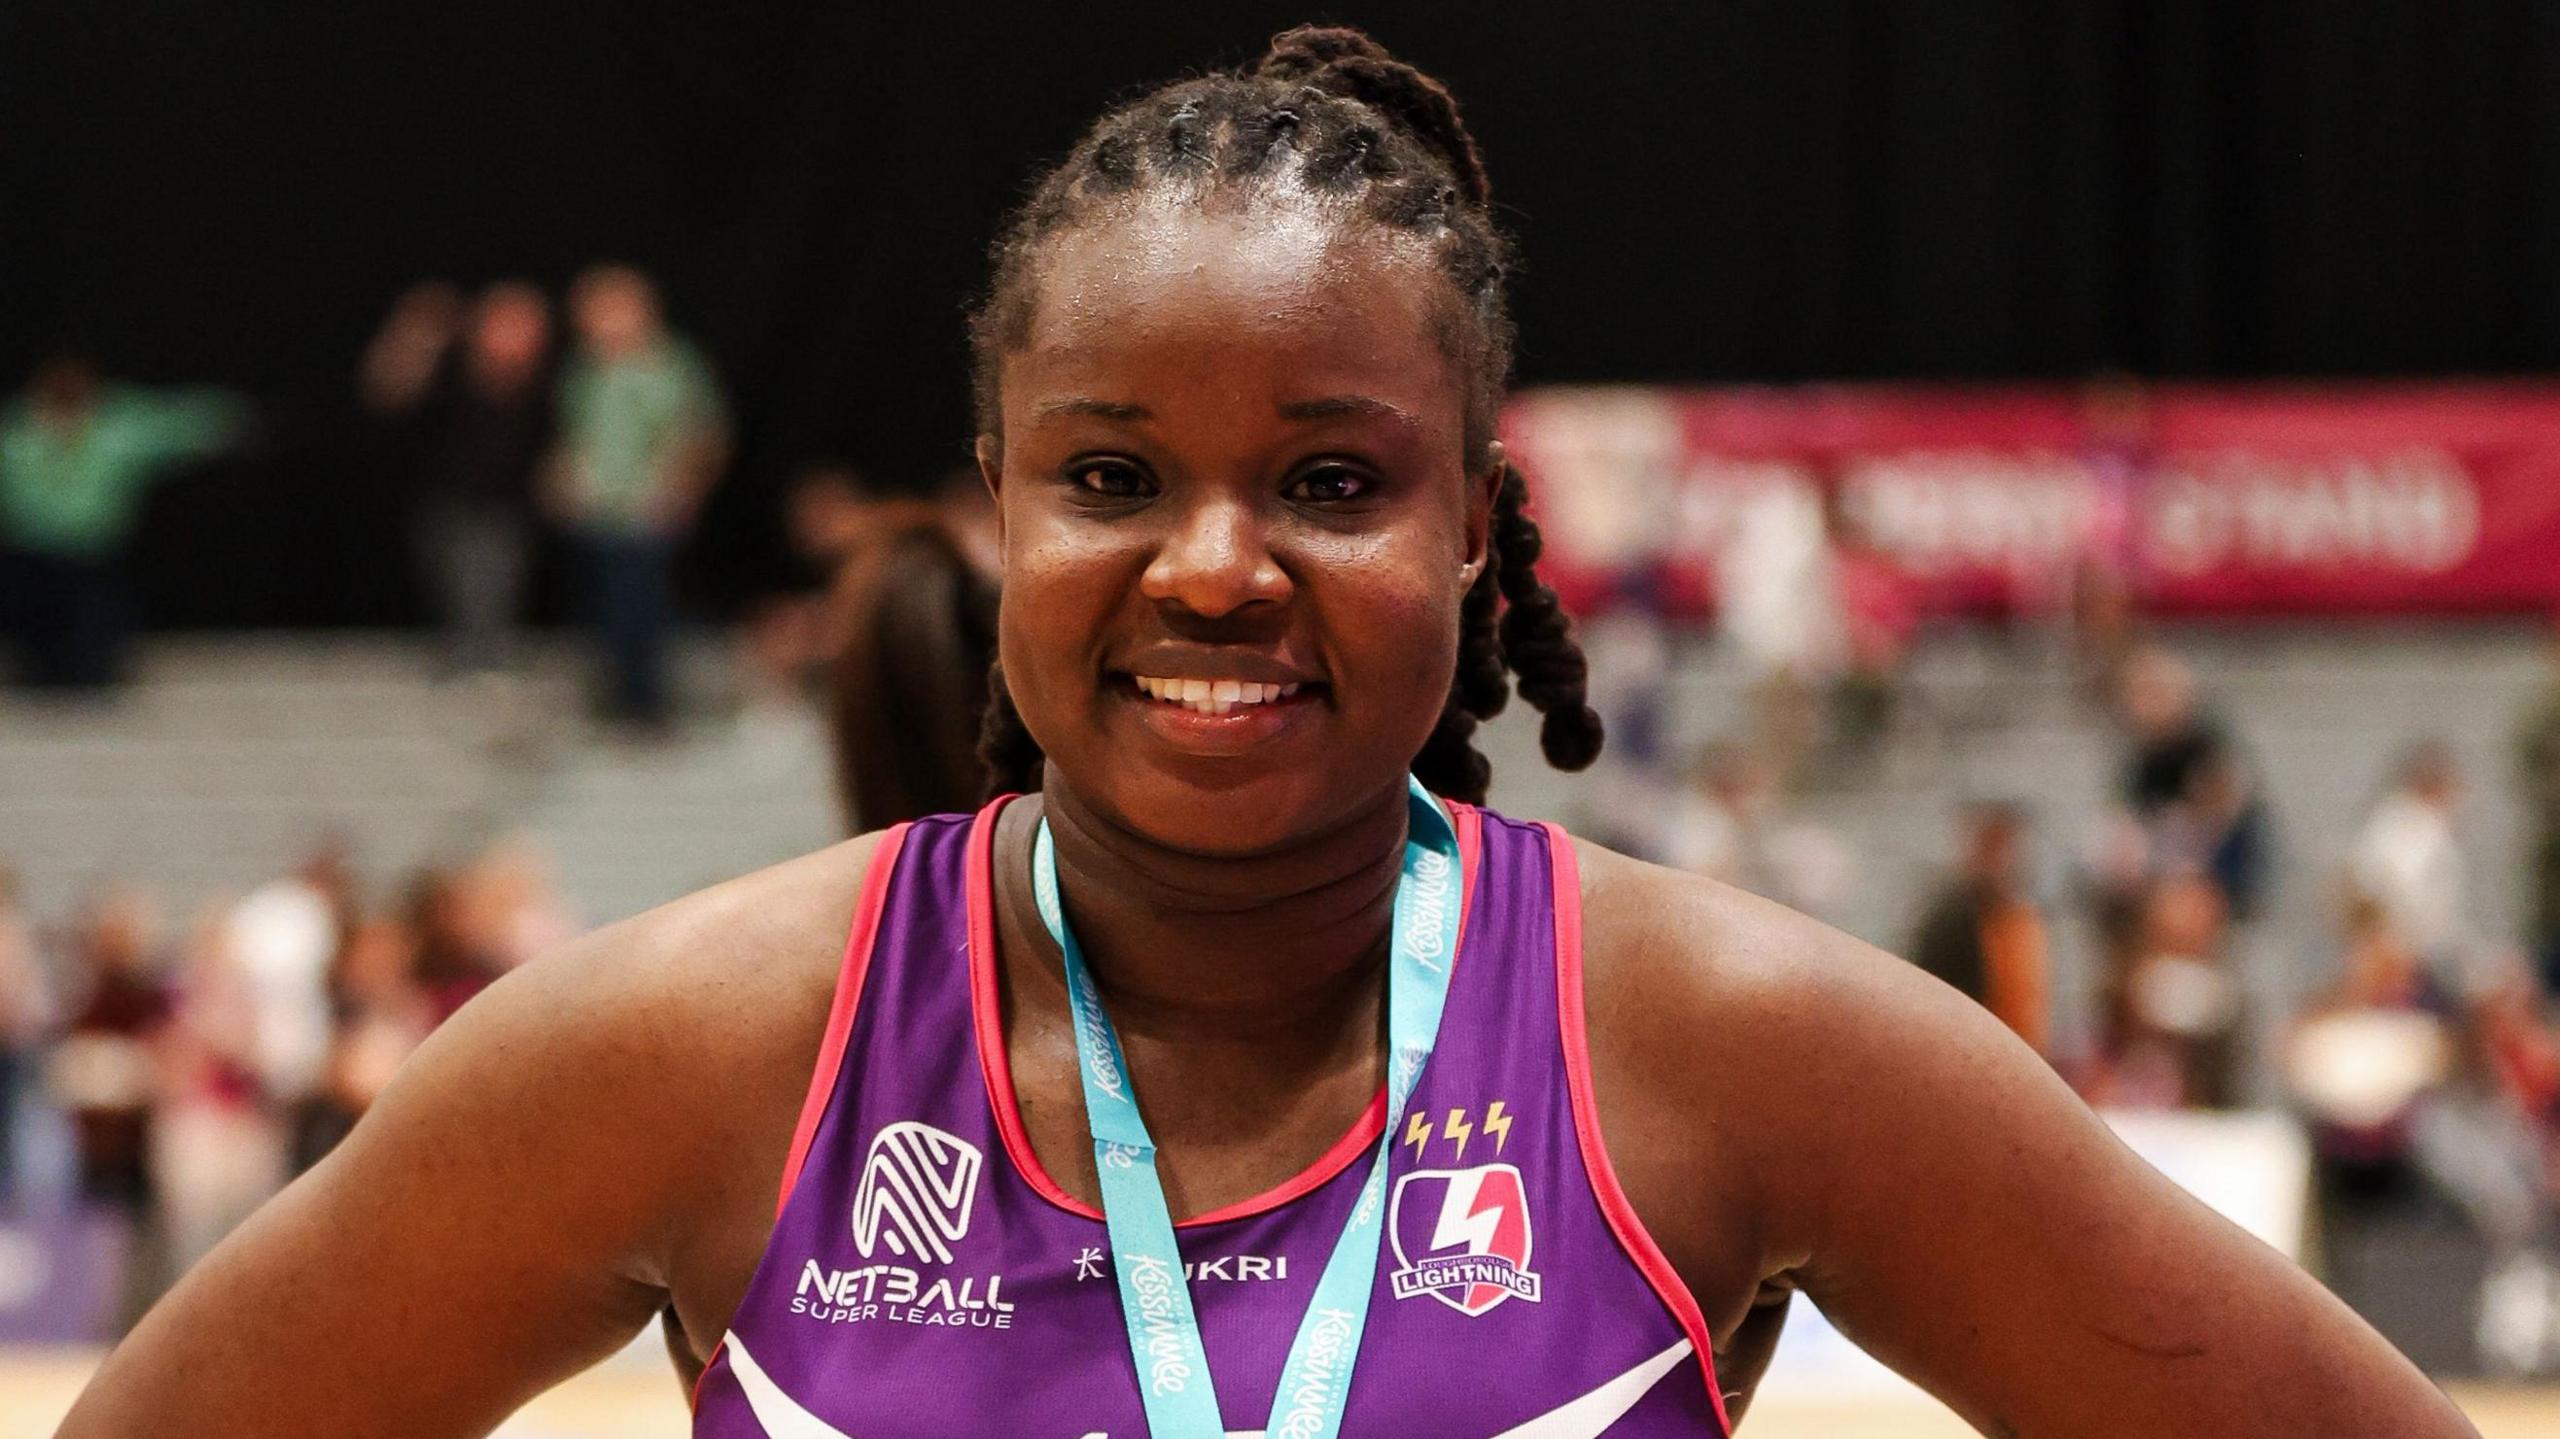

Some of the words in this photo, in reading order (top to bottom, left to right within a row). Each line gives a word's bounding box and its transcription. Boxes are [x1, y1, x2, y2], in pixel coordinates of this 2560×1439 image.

[796, 1259, 1015, 1313] NETBALL
[1401, 1264, 1532, 1294] LIGHTNING
[790, 1297, 879, 1324] SUPER
[888, 1305, 1013, 1329] LEAGUE
[1123, 1253, 1192, 1398] Kissimmee
